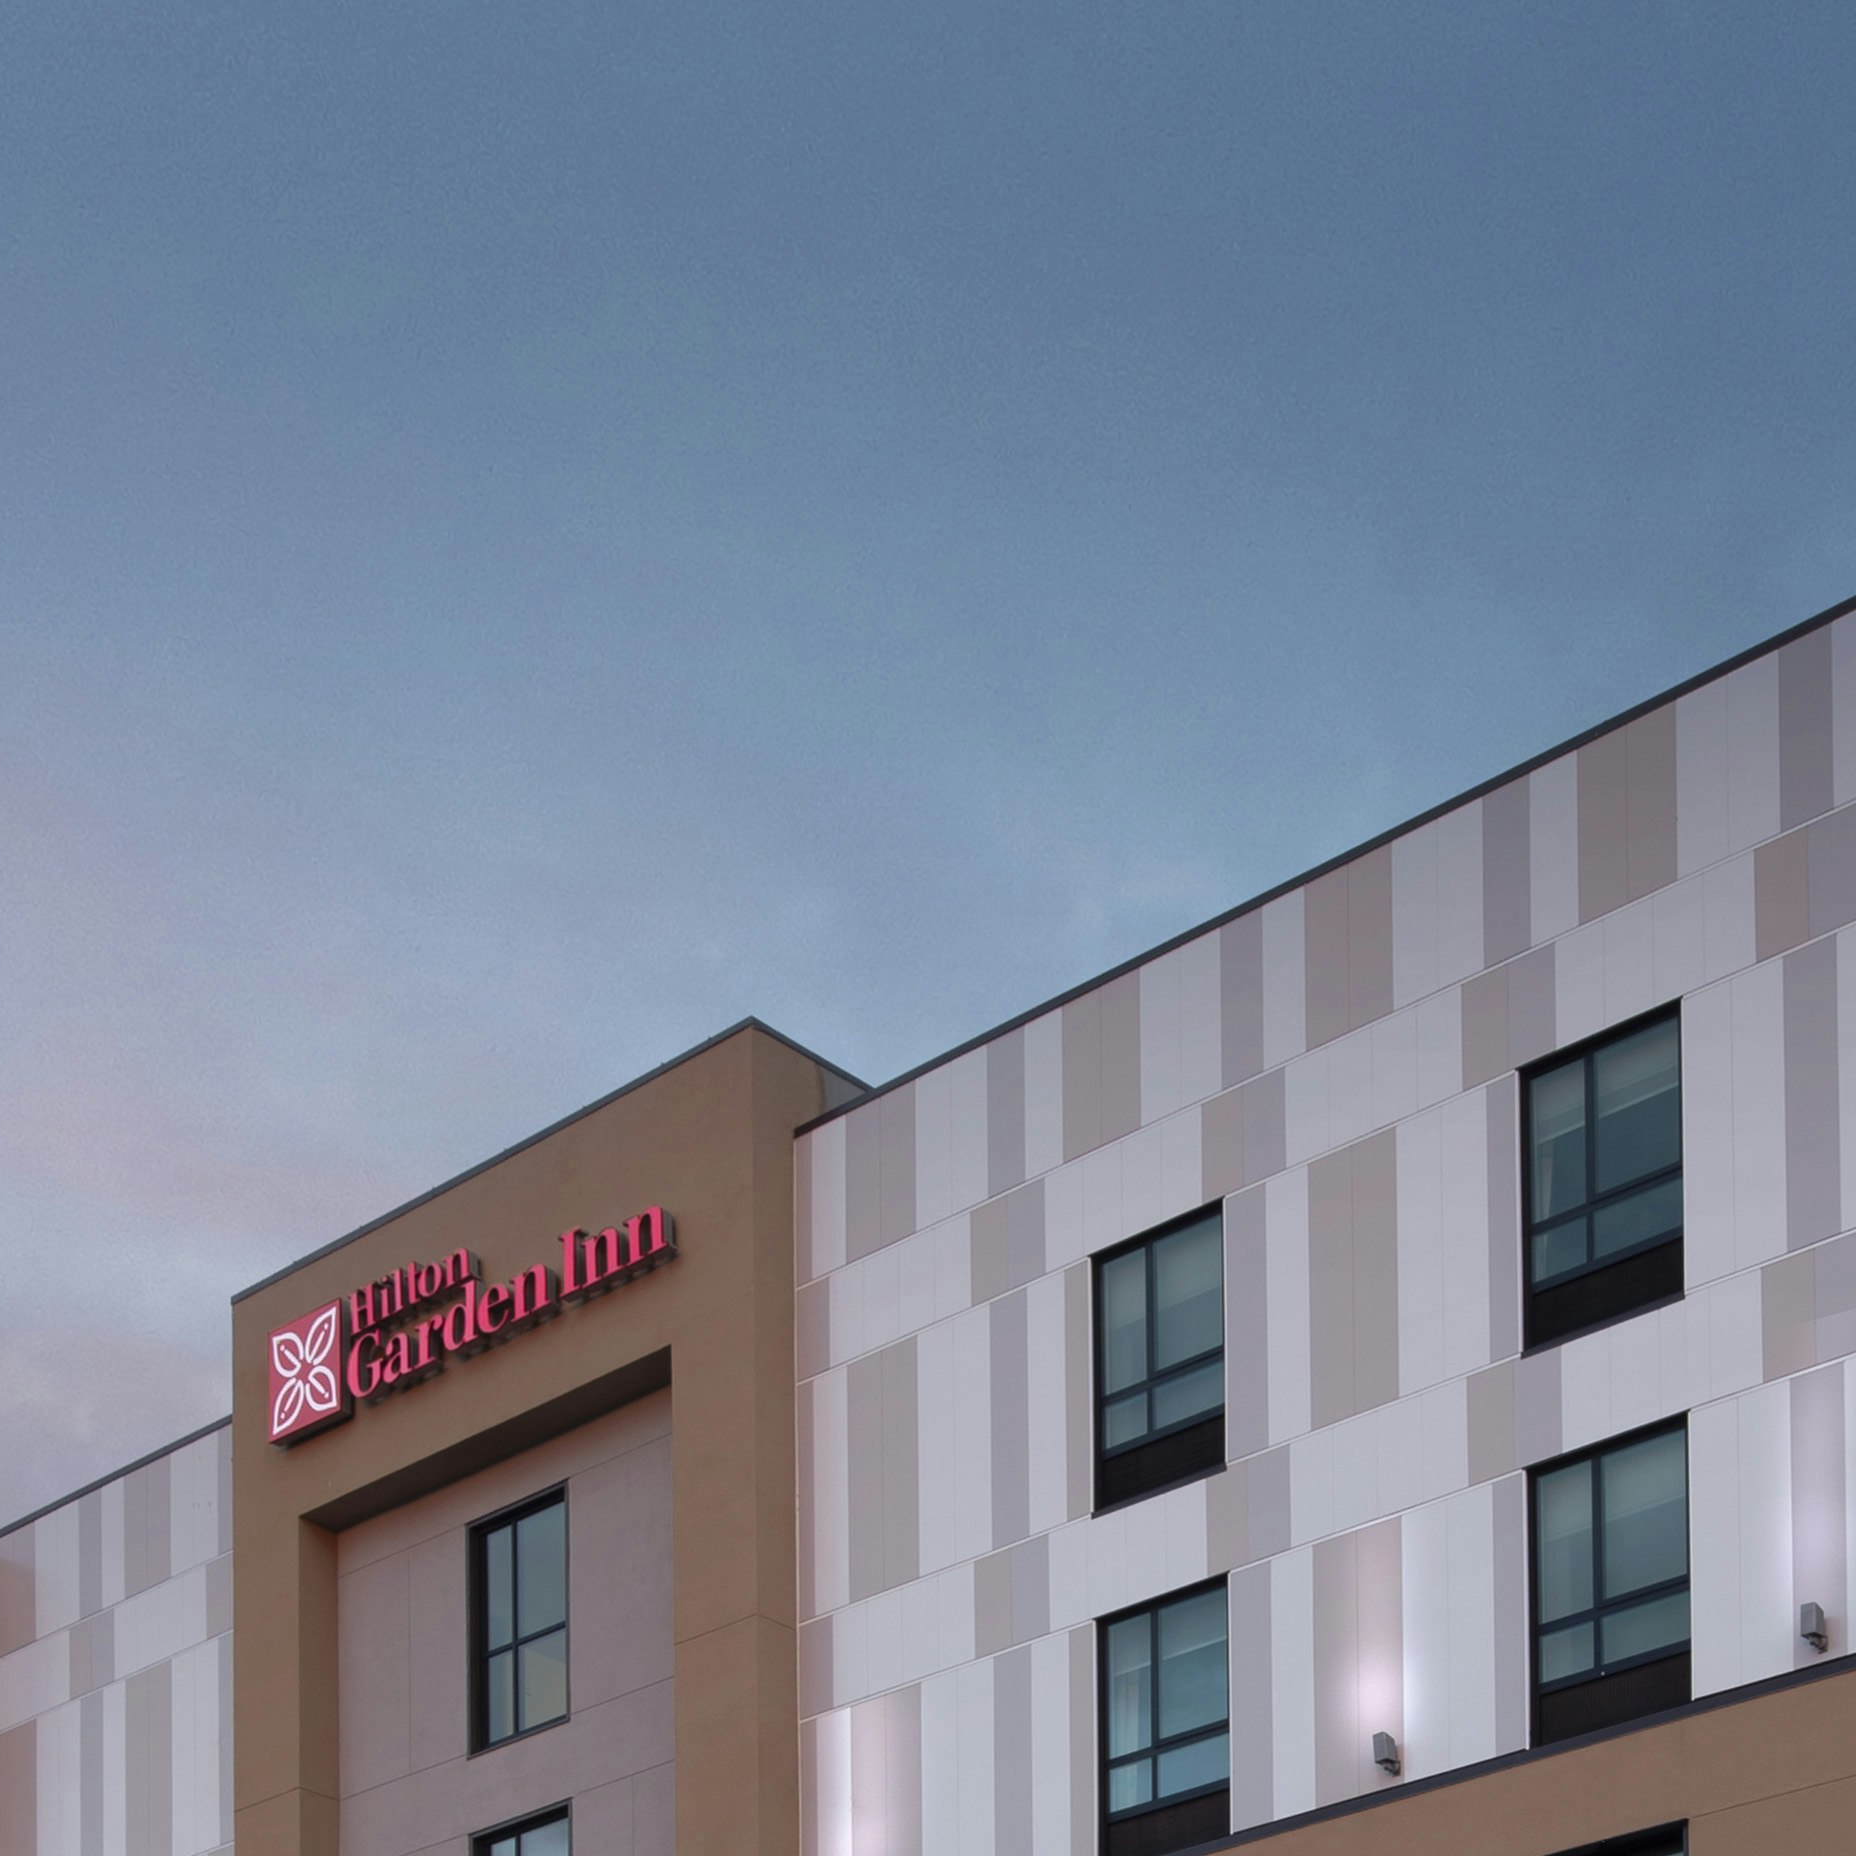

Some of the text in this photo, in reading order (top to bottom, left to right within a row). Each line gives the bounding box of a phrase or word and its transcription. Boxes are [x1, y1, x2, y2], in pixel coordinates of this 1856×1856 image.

[346, 1204, 671, 1399] Garden Inn
[347, 1247, 472, 1336] Hilton
